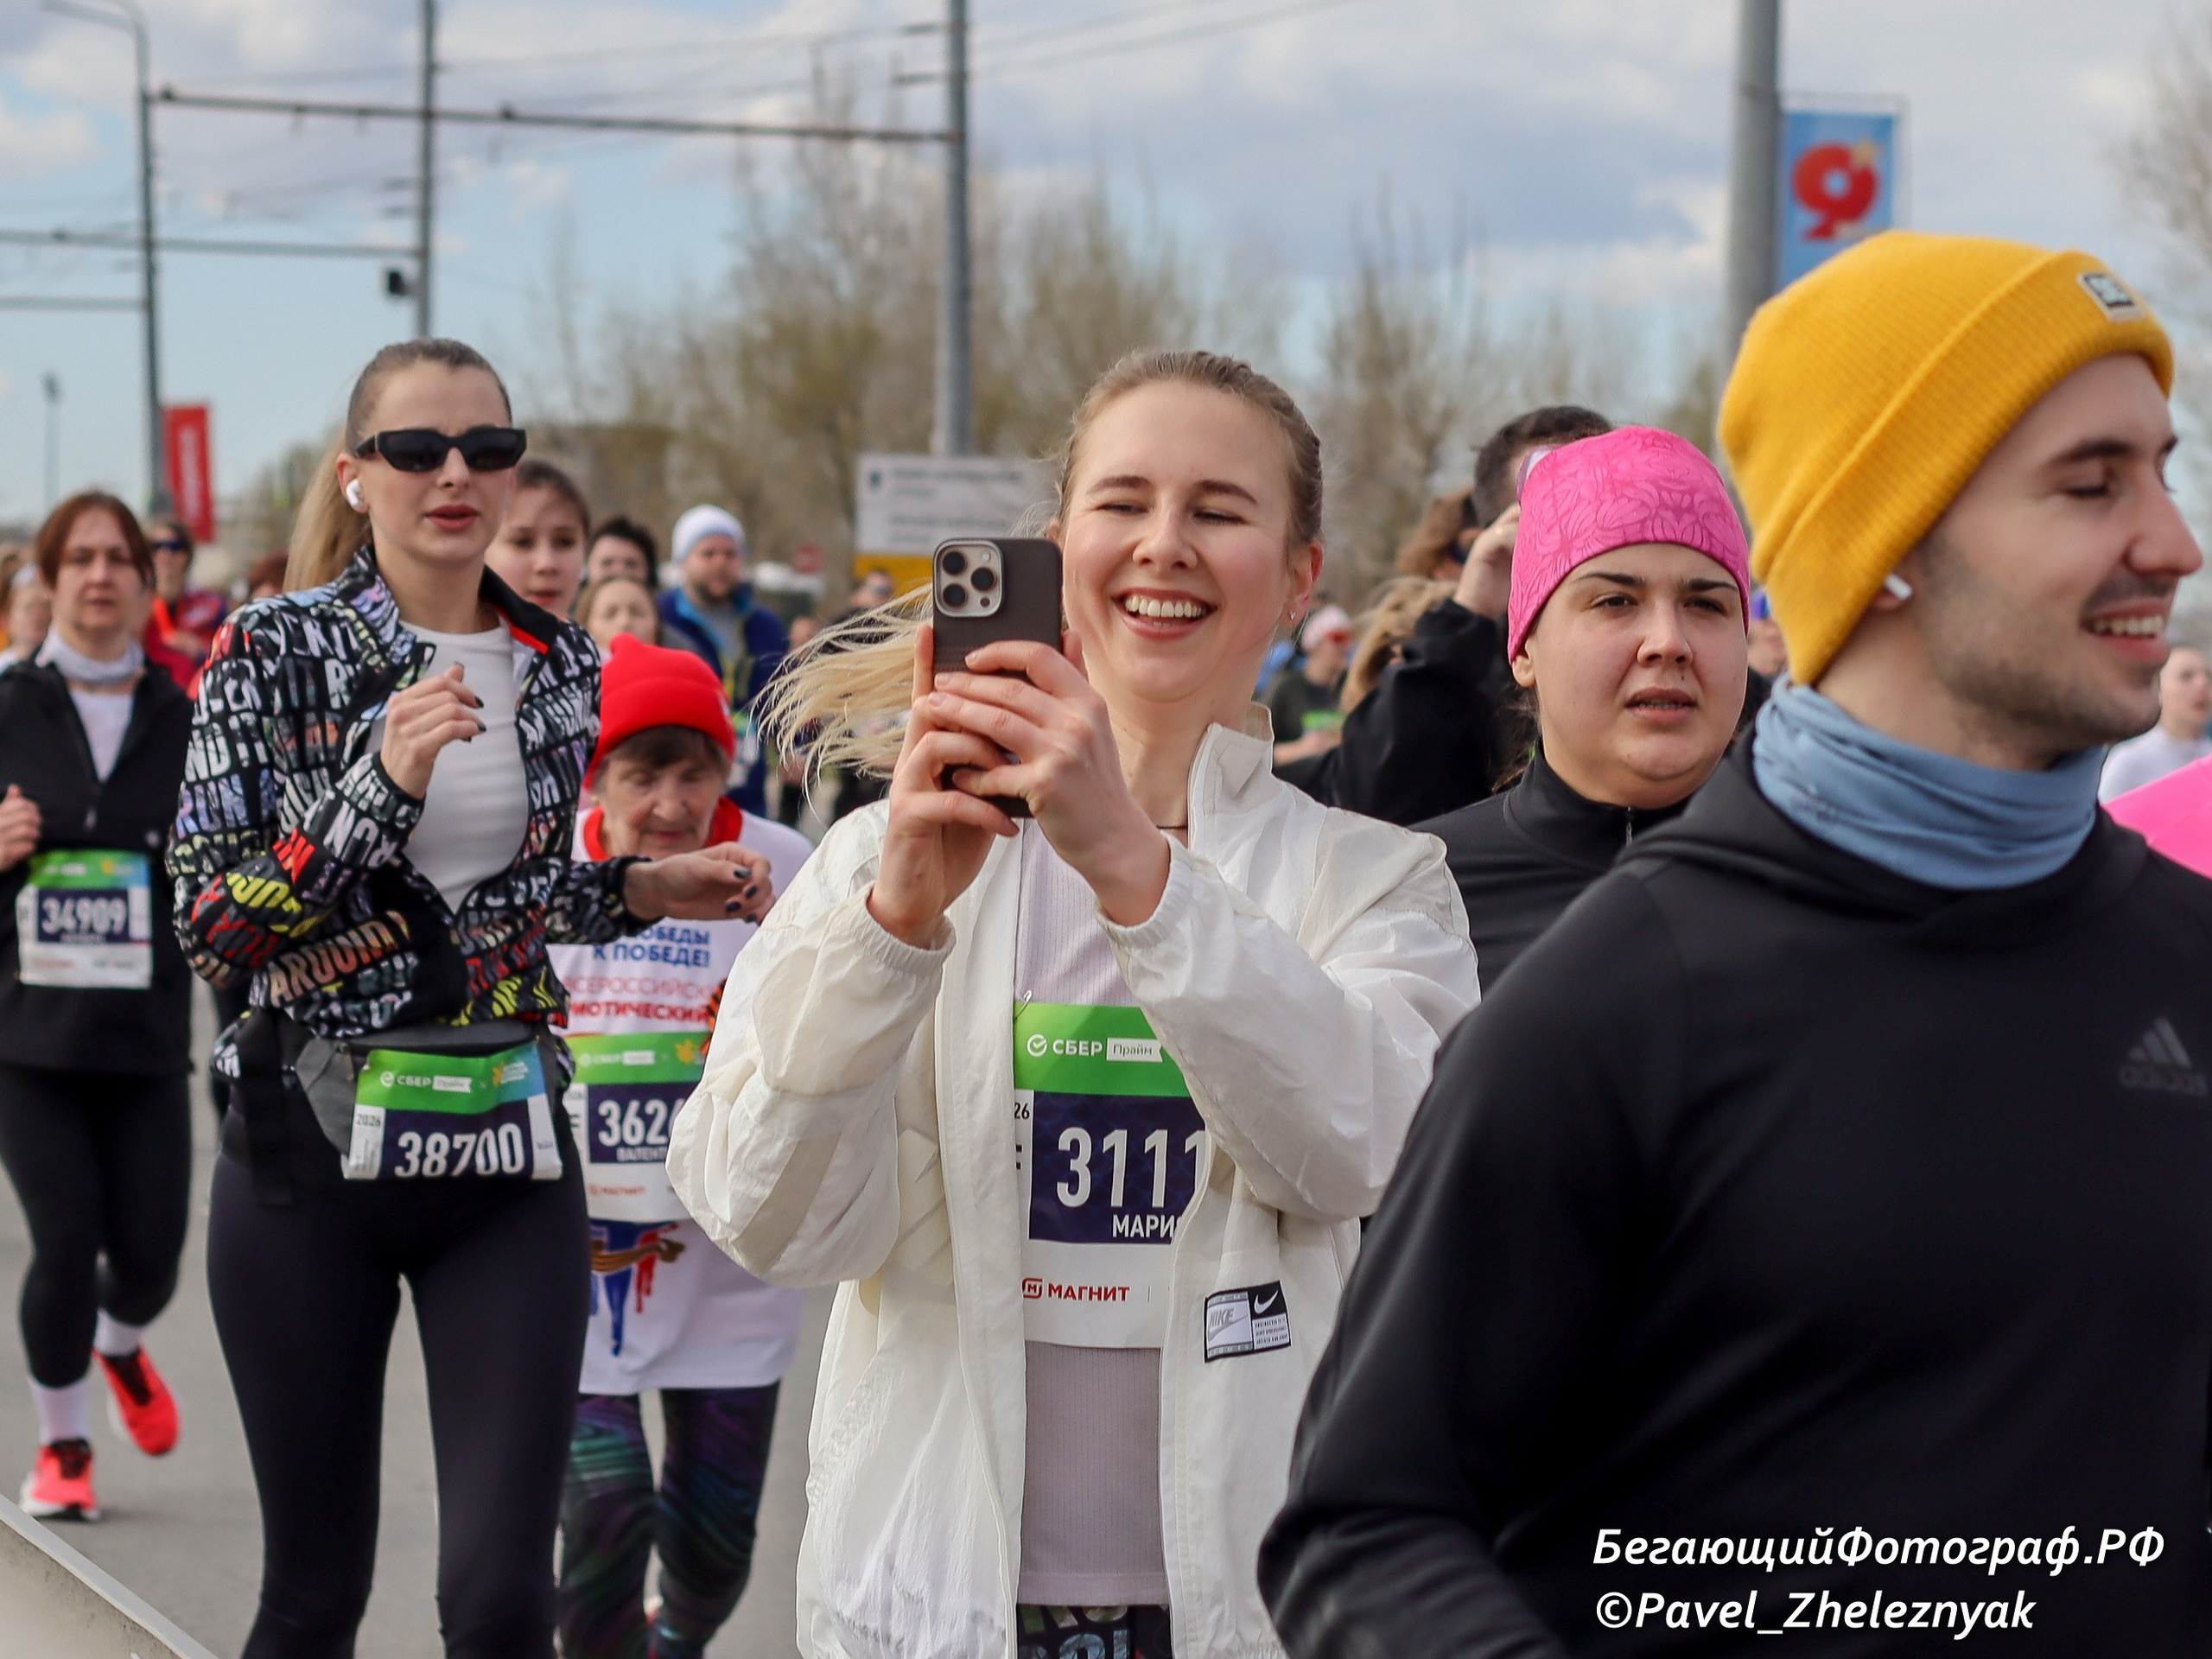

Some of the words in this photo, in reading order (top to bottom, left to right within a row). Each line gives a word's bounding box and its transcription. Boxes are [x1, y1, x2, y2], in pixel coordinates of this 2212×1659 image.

[1791, 141, 1878, 241] 9
[1052, 1039, 1103, 1056] СБЕР
[1113, 1044, 1153, 1057] Прайм
[1014, 1103, 1030, 1120] 26
[395, 1123, 525, 1178] 38700
[1056, 1127, 1206, 1208] 3111
[1112, 1214, 1180, 1238] МАРИ
[1047, 1282, 1129, 1302] МАГНИТ
